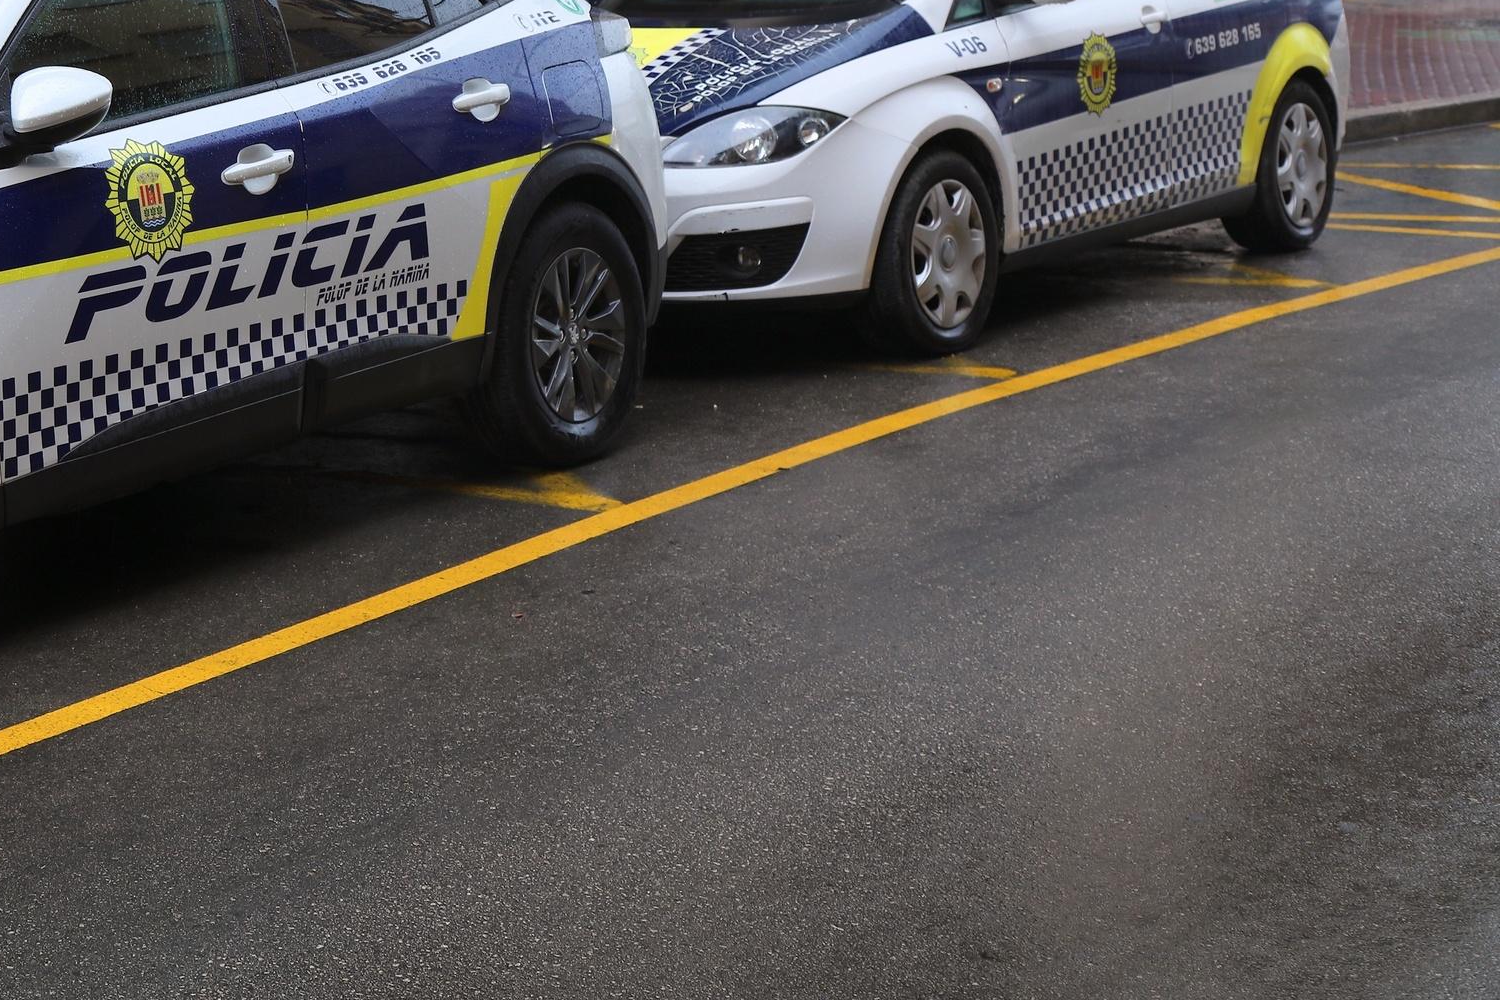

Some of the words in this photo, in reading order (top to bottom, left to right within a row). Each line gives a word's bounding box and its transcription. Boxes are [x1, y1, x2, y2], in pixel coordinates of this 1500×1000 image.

[945, 36, 987, 57] V-06
[1194, 34, 1217, 55] 639
[1218, 27, 1240, 49] 628
[1241, 22, 1262, 42] 165
[410, 47, 442, 65] 165
[695, 59, 762, 91] POLICIA
[120, 155, 145, 189] POLICIA
[149, 155, 177, 181] LOCAL
[121, 207, 140, 233] POLOP
[143, 231, 154, 241] DE
[156, 230, 166, 239] LA
[64, 203, 430, 344] POLICIA
[316, 281, 352, 306] POLOP
[355, 276, 370, 297] DE
[372, 273, 386, 292] LA
[389, 262, 430, 288] MARINA
